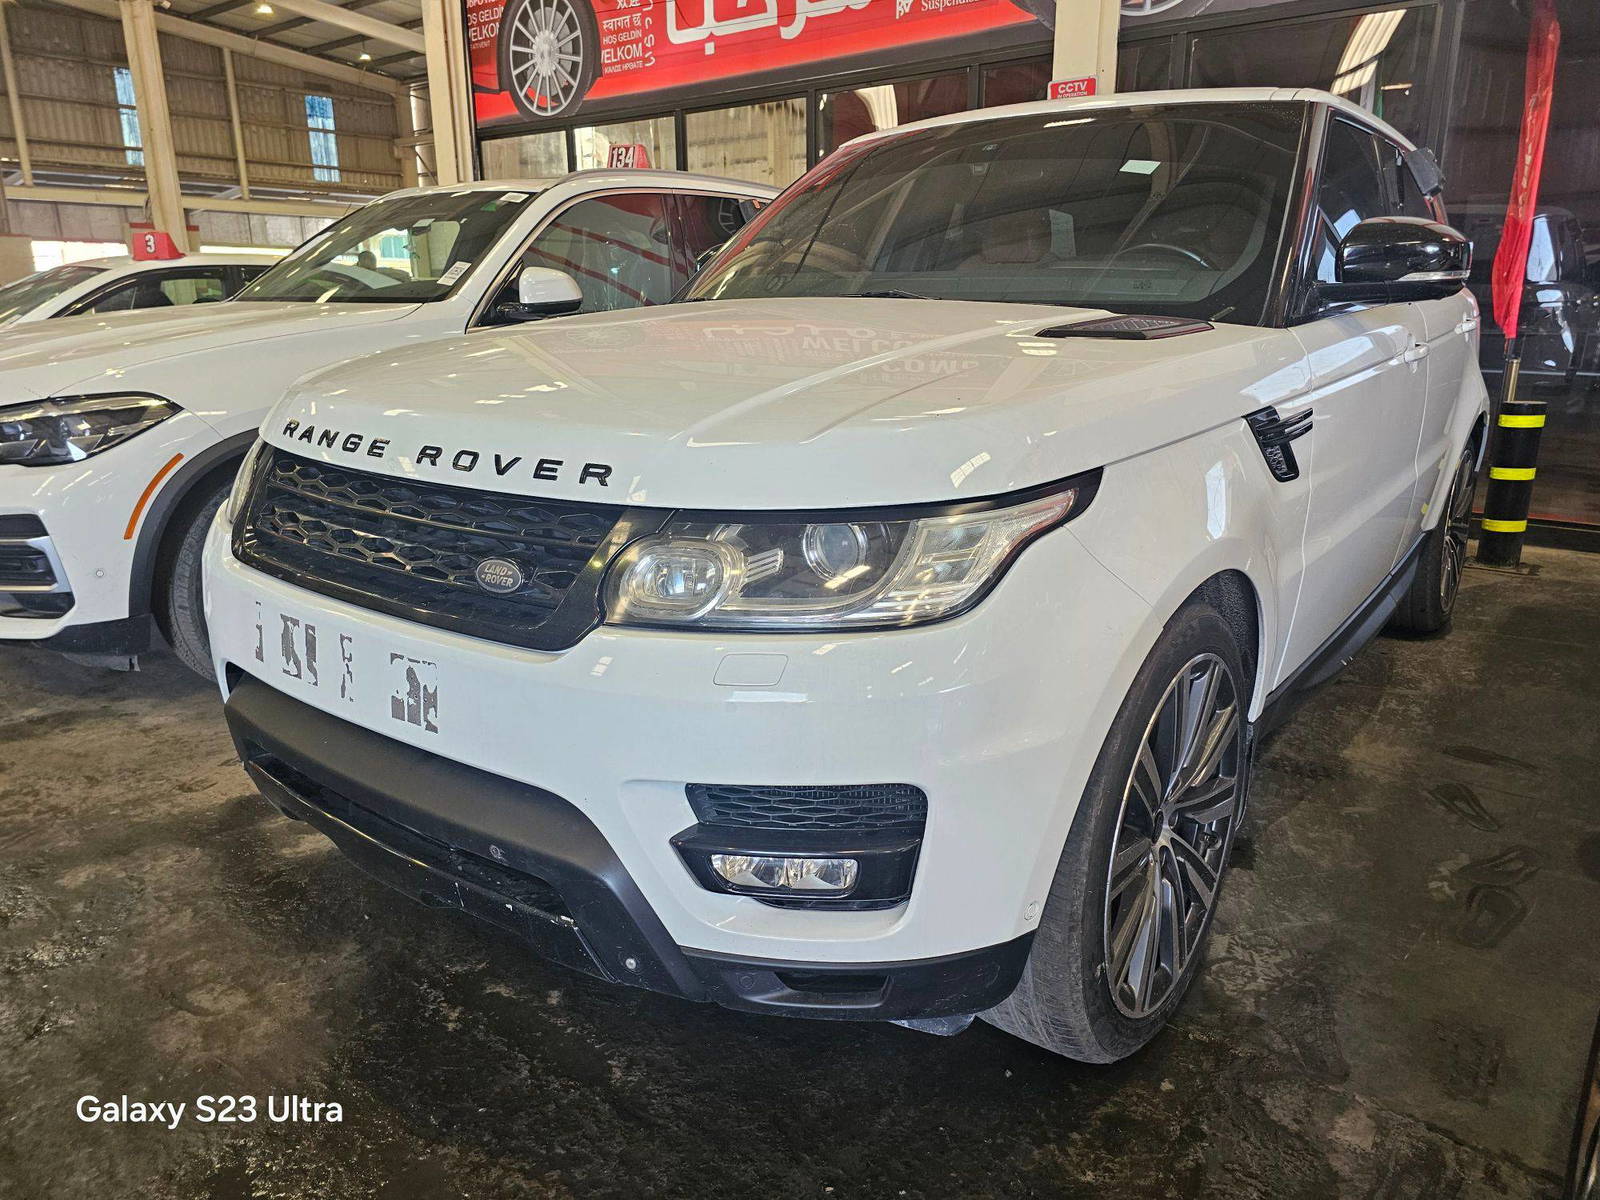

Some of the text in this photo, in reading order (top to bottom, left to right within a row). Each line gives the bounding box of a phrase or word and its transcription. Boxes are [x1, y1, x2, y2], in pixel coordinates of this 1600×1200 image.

[1058, 81, 1087, 94] CCTV
[612, 146, 634, 168] 134
[145, 234, 155, 253] 3
[283, 418, 613, 487] RANGE ROVER
[484, 564, 507, 576] LAND
[485, 573, 513, 587] ROVER
